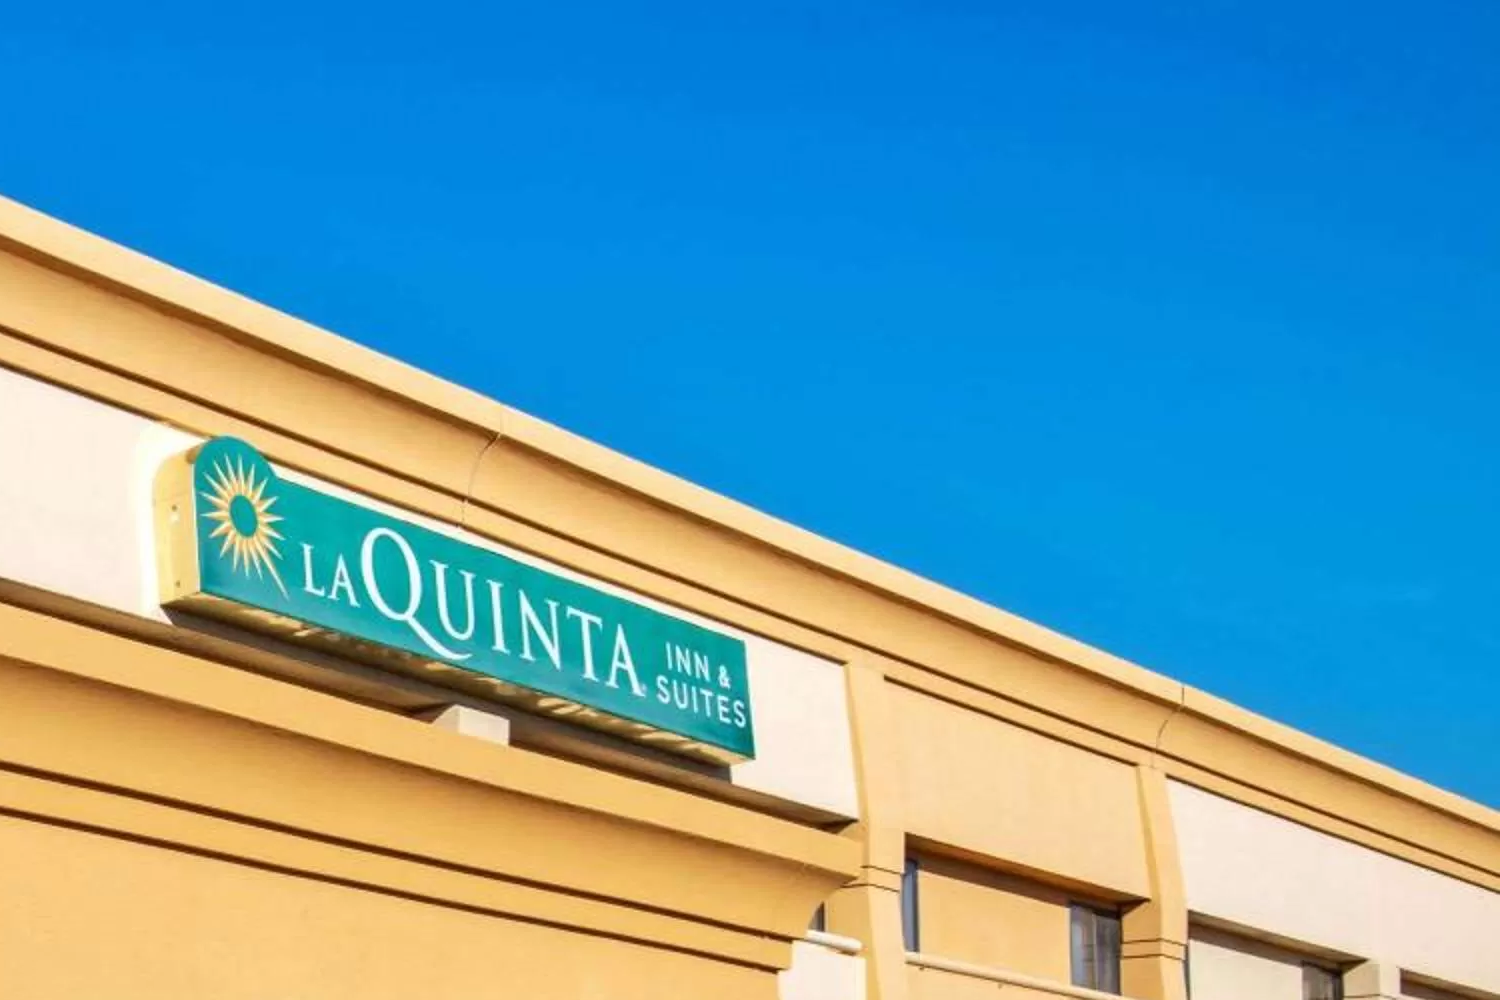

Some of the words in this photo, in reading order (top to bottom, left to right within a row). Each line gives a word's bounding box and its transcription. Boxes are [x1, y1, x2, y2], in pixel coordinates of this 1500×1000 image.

[300, 542, 361, 608] LA
[361, 527, 646, 697] QUINTA
[665, 641, 711, 682] INN
[718, 665, 731, 690] &
[656, 674, 747, 728] SUITES
